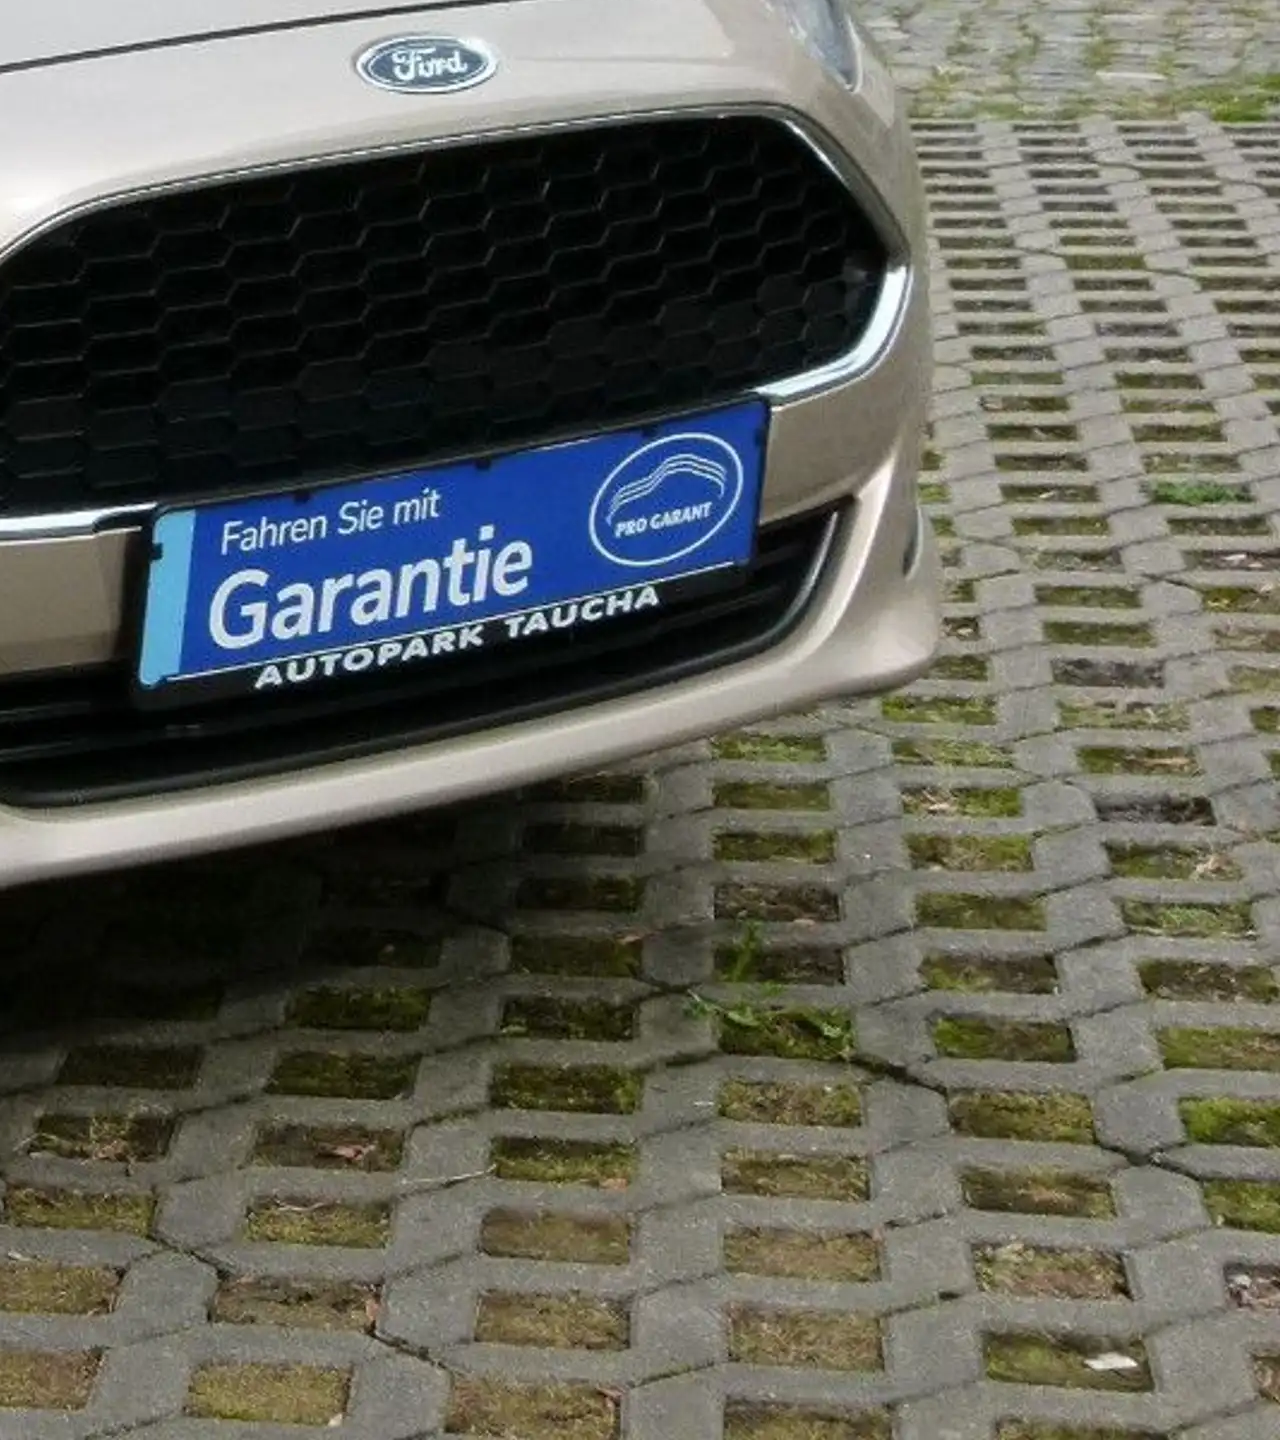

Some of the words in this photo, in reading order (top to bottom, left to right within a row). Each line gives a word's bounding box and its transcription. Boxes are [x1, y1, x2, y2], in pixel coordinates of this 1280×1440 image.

[391, 47, 468, 81] Ford
[220, 516, 327, 556] Fahren
[337, 499, 384, 535] Sie
[393, 488, 441, 526] mit
[615, 517, 647, 539] PRO
[650, 501, 713, 531] GARANT
[208, 524, 533, 650] Garantie
[254, 625, 485, 691] AUTOPARK
[503, 586, 659, 638] TAUCHA
